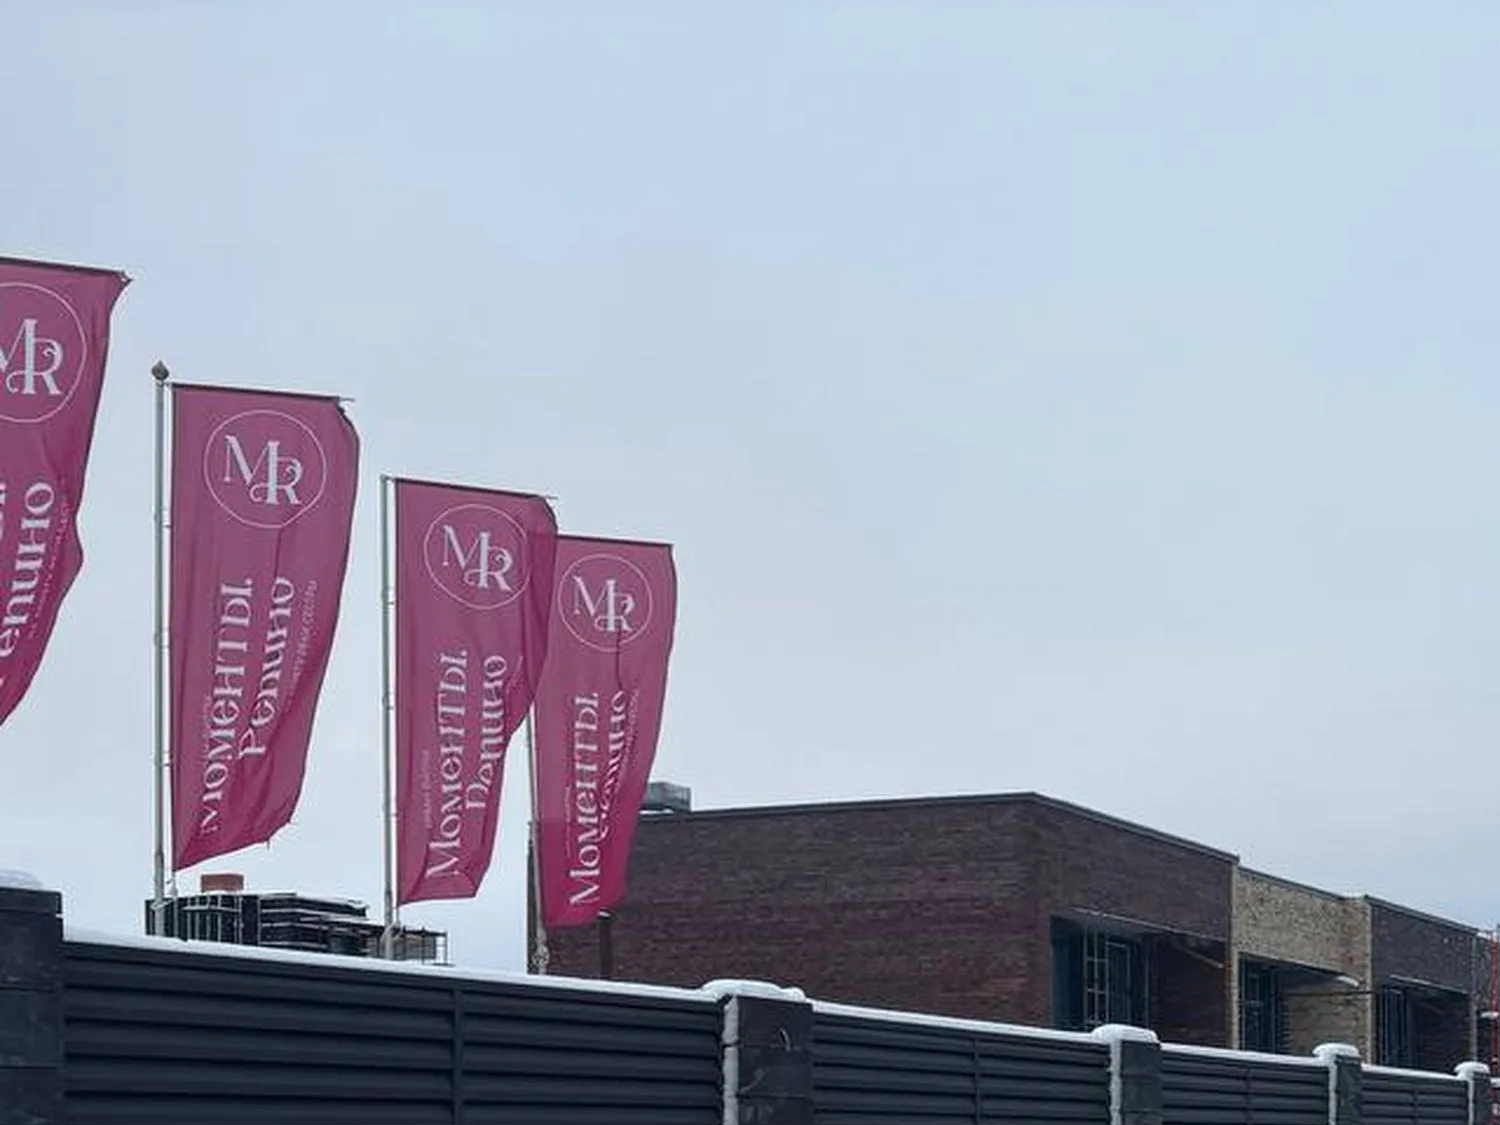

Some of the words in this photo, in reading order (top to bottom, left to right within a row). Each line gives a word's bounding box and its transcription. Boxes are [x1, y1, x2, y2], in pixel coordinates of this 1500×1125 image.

[223, 434, 304, 505] MR
[0, 482, 55, 688] епино
[442, 524, 513, 593] MR
[572, 575, 633, 634] MR
